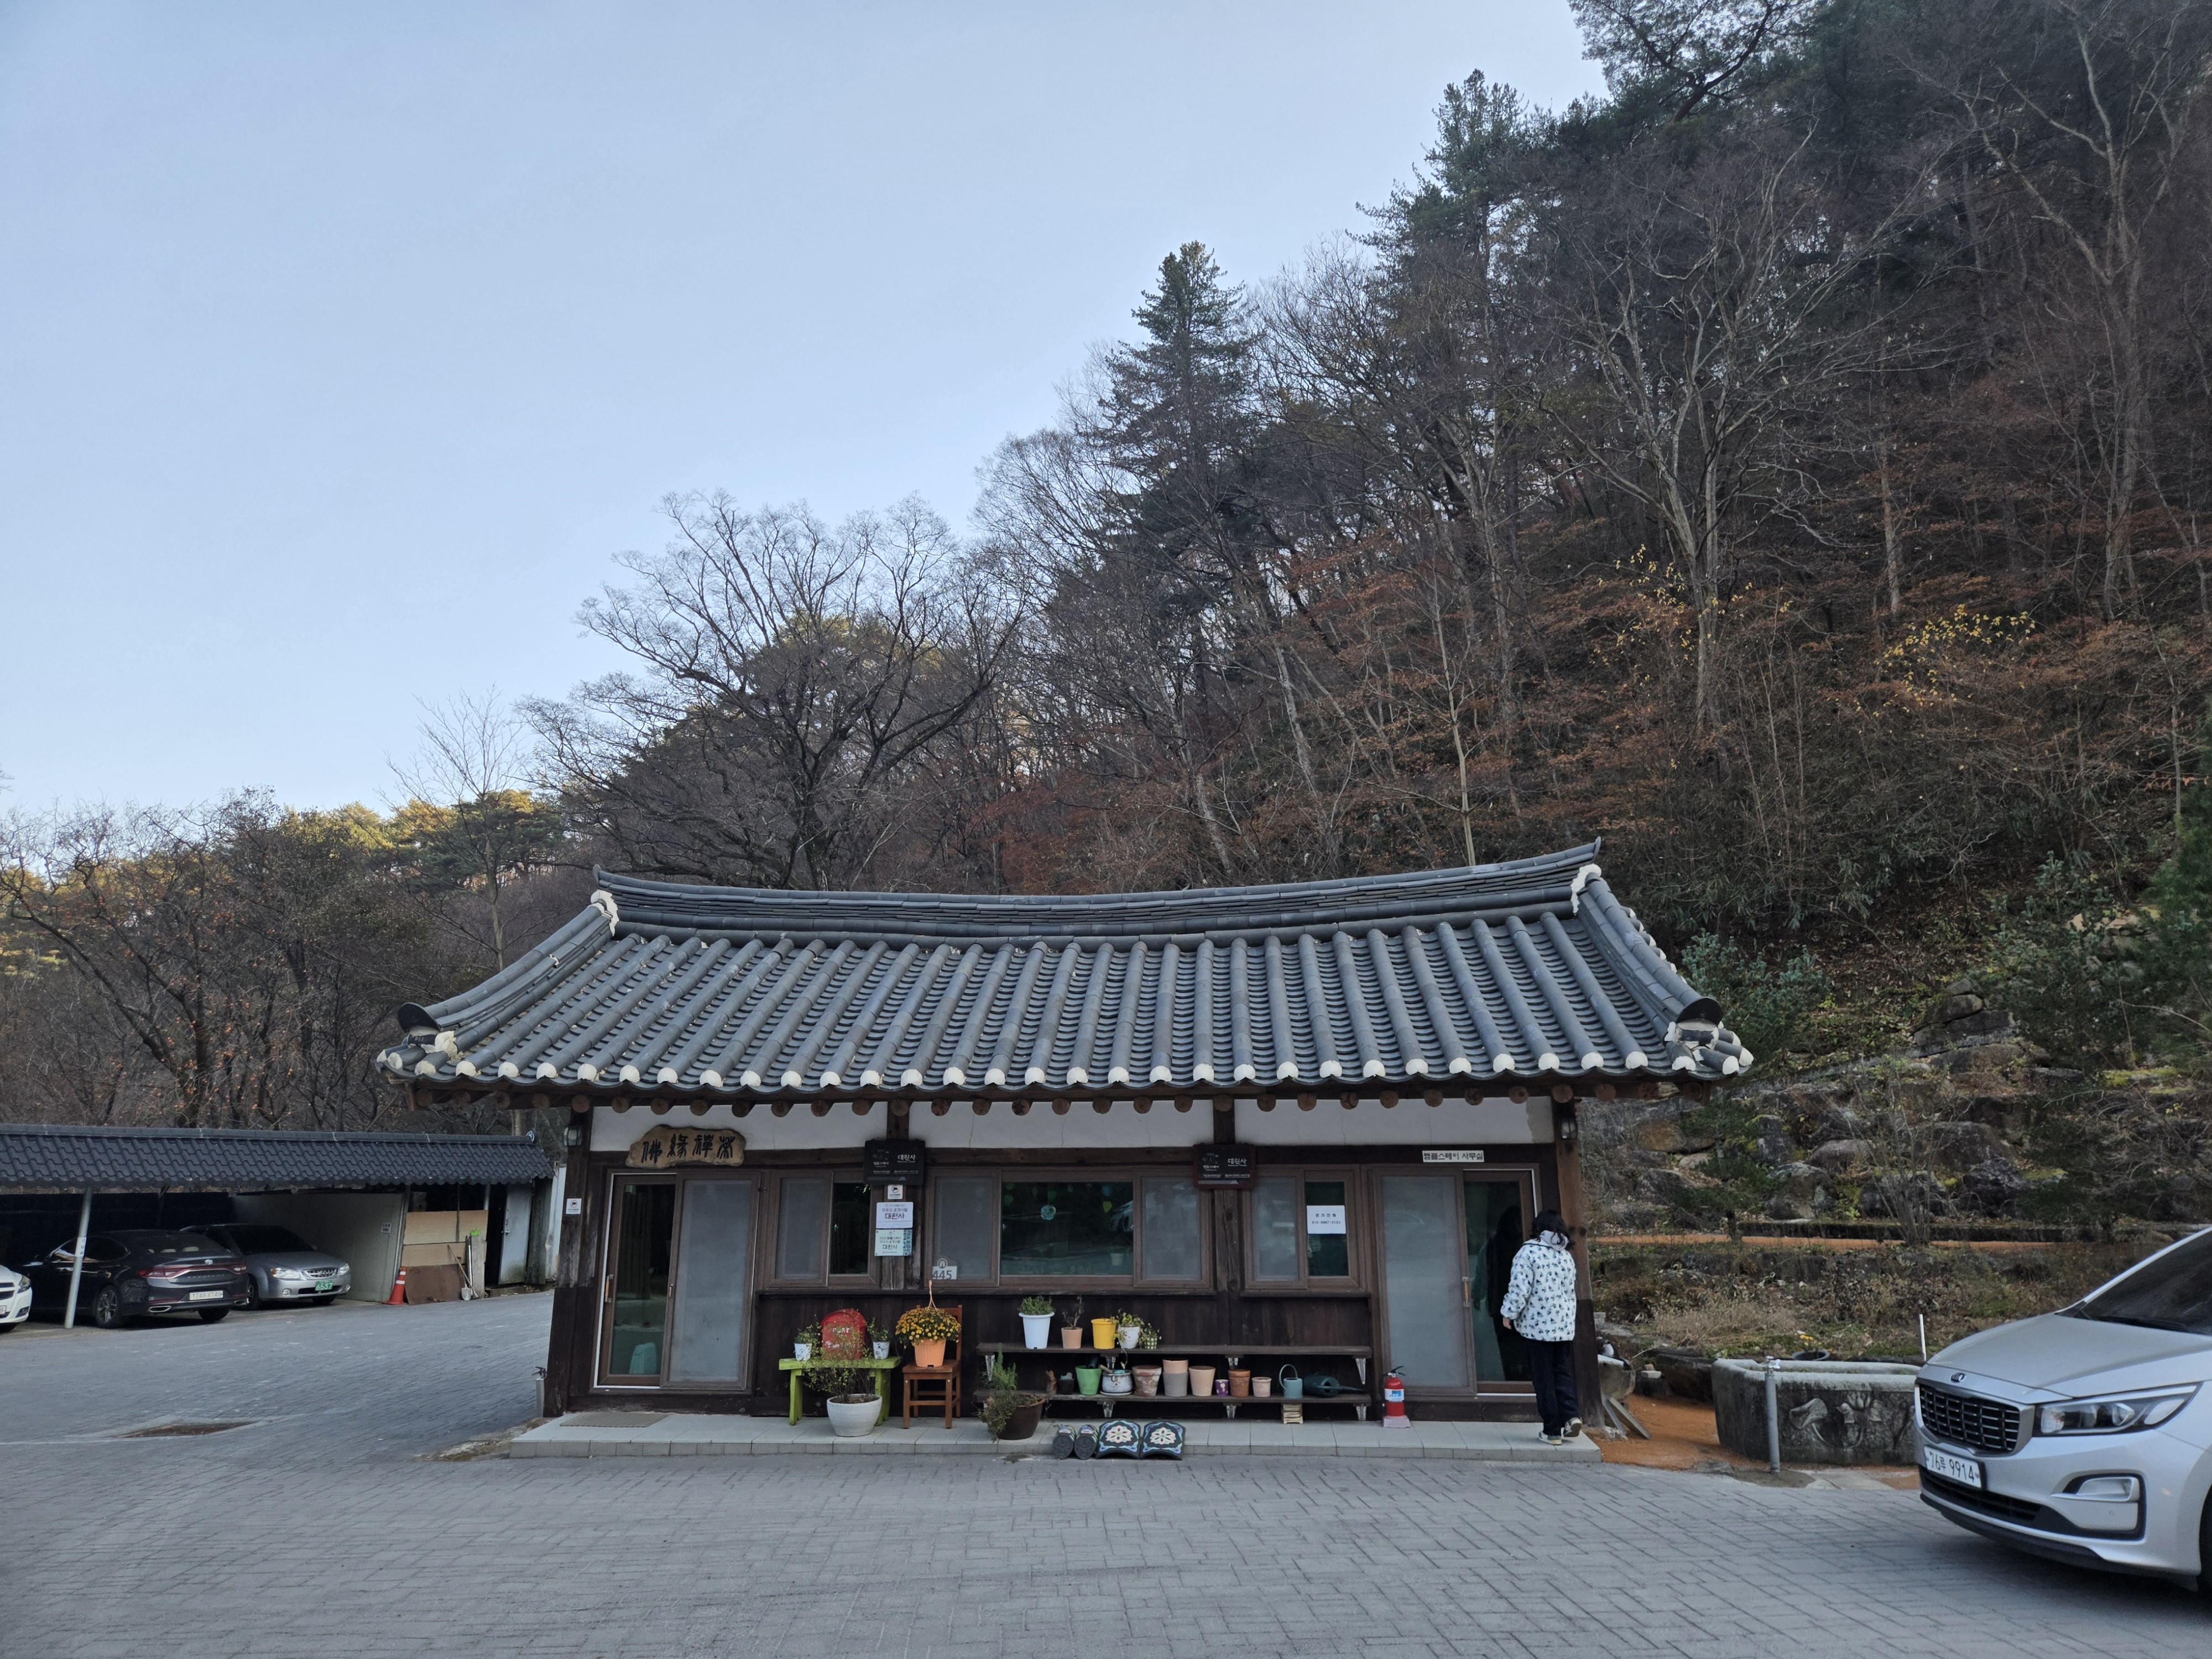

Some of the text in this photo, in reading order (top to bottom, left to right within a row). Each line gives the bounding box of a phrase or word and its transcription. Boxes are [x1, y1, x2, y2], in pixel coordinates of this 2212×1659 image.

[932, 1270, 952, 1280] 445
[1929, 1451, 1975, 1483] 76루 9914
